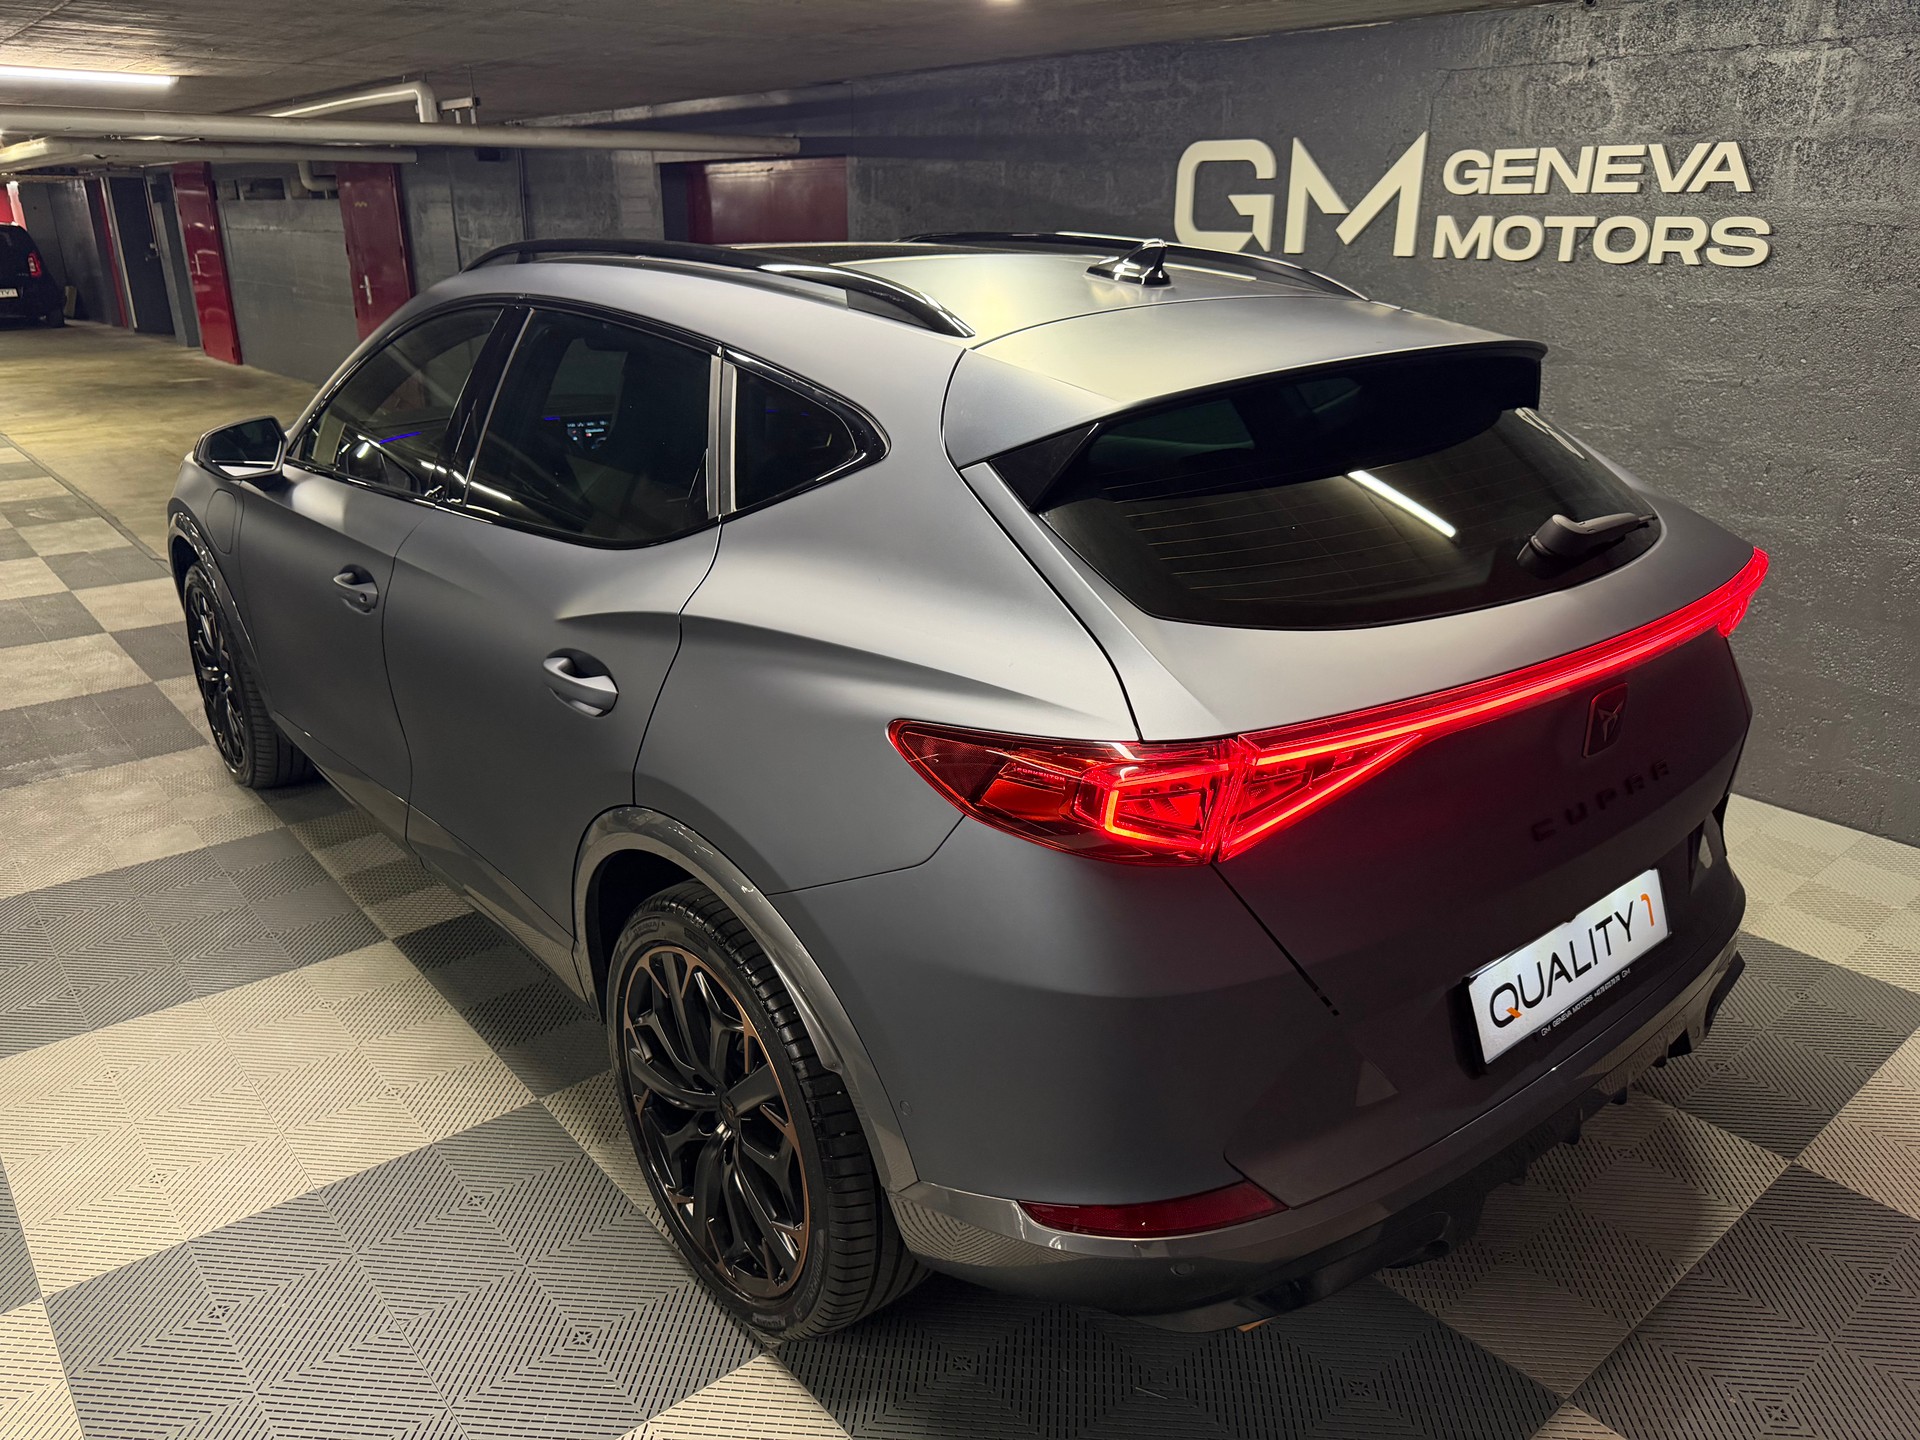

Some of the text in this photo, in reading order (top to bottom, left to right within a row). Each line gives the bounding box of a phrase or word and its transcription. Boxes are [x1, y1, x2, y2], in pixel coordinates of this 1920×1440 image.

[1173, 131, 1428, 257] GM
[1441, 141, 1754, 196] GENEVA
[1432, 214, 1773, 268] MOTORS
[1489, 901, 1634, 1028] QUALITY
[1572, 994, 1594, 1013] MOTORS
